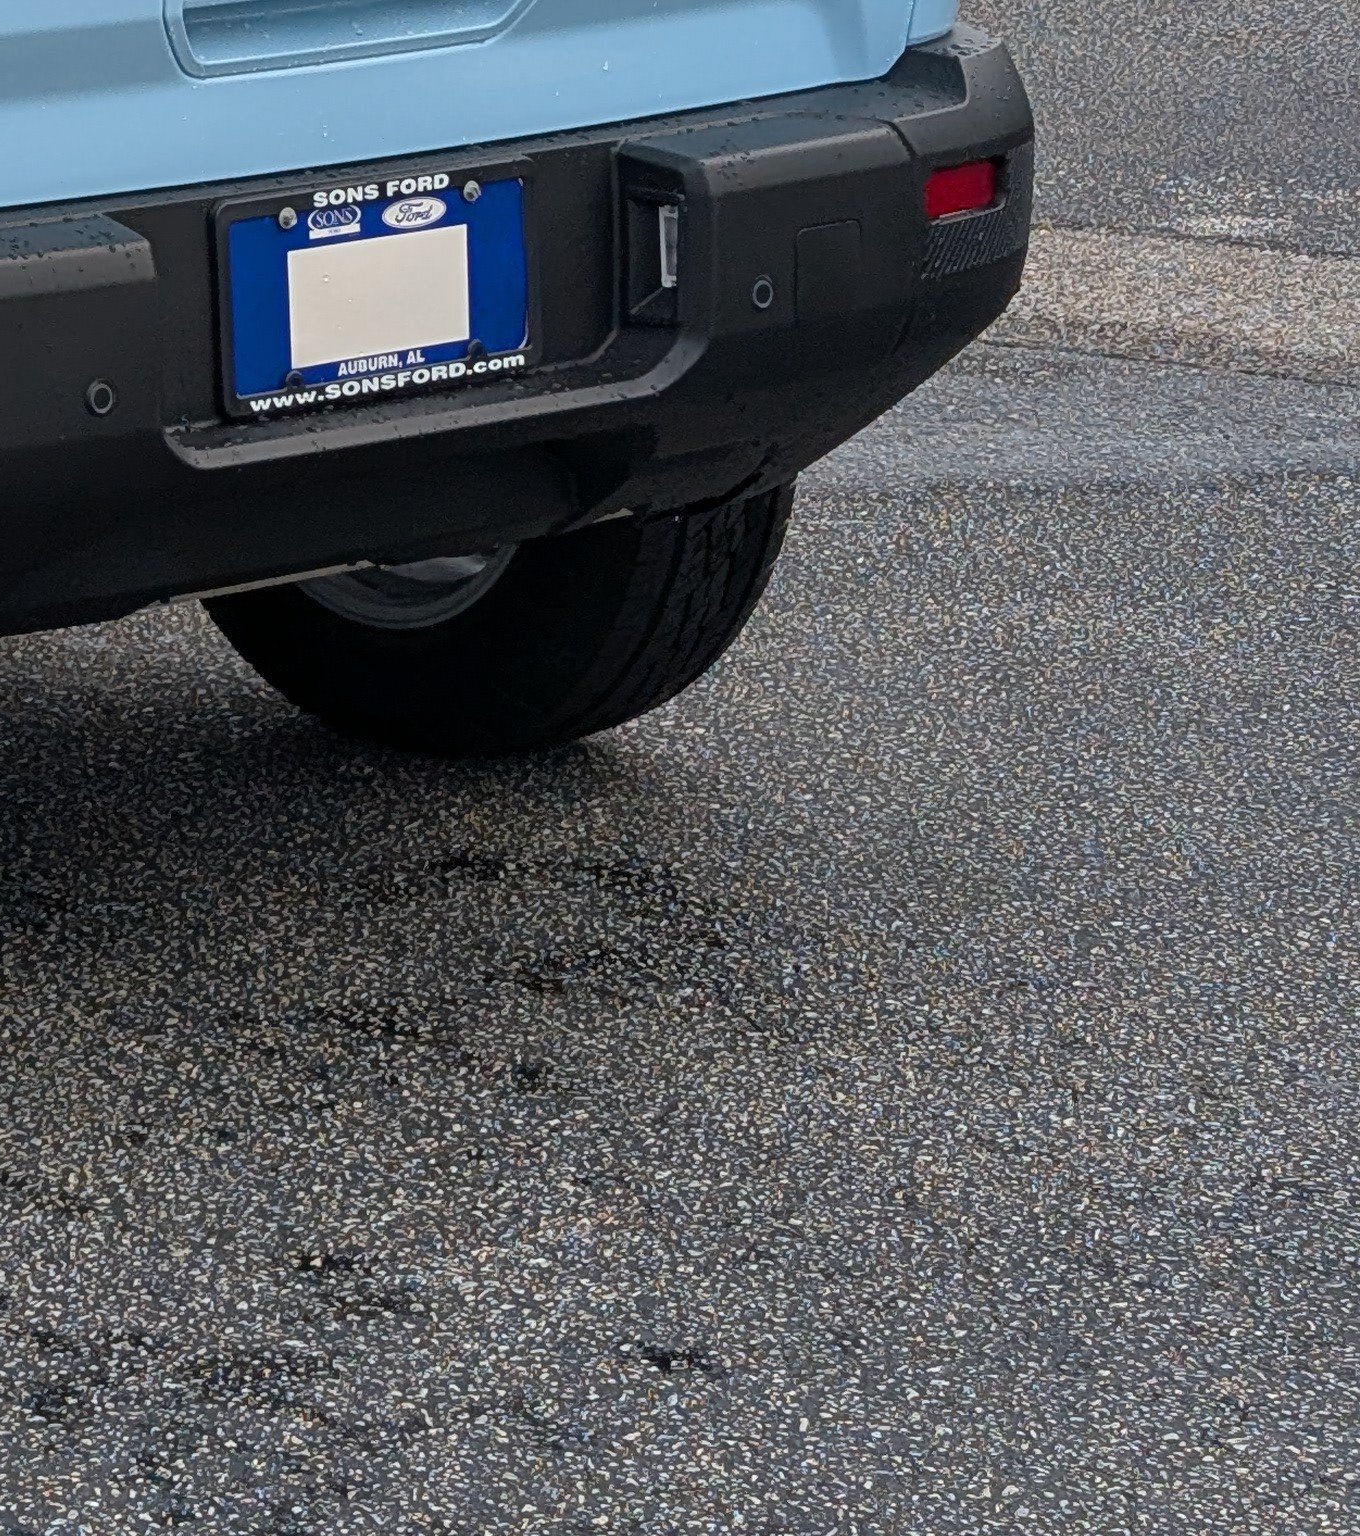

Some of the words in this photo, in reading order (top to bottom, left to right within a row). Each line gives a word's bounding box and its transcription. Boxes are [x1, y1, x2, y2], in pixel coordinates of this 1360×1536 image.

[313, 183, 380, 208] SONS
[386, 172, 450, 197] FORD
[315, 207, 354, 228] SONS
[394, 202, 434, 224] Ford
[337, 351, 403, 378] AUBURN,
[405, 349, 426, 366] AL
[249, 353, 525, 413] www.SONSFORD.com
